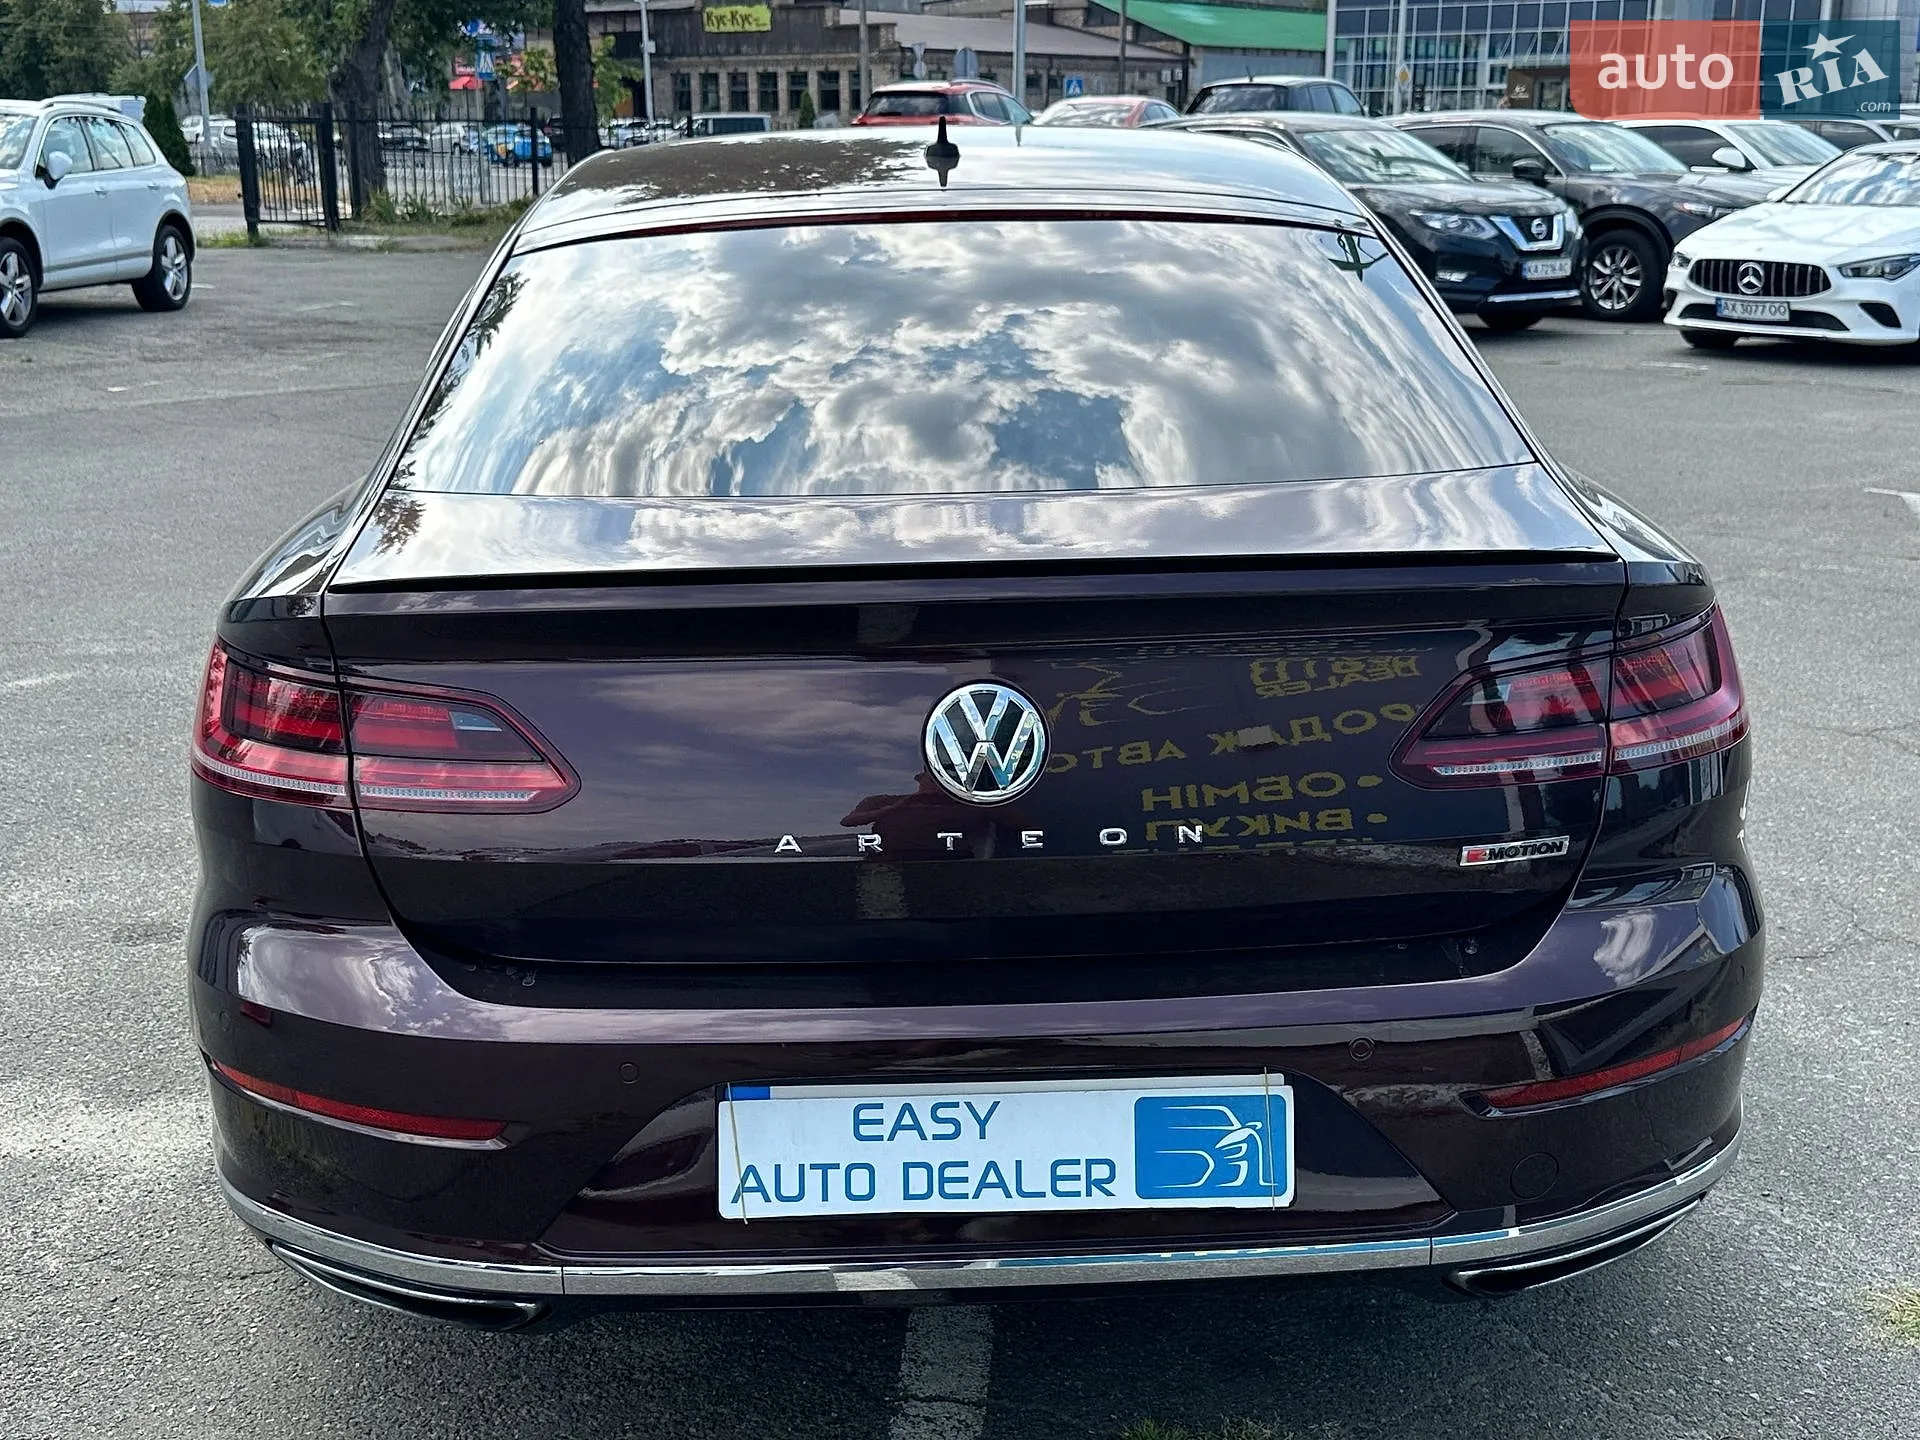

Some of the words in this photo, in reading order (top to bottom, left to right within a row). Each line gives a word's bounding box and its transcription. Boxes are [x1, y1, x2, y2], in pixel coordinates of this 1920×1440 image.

[1724, 301, 1737, 313] AX
[1740, 303, 1766, 315] 3077
[774, 825, 1204, 853] ARTEON
[853, 1101, 1001, 1142] EASY
[730, 1161, 876, 1204] AUTO
[902, 1157, 1117, 1201] DEALER
